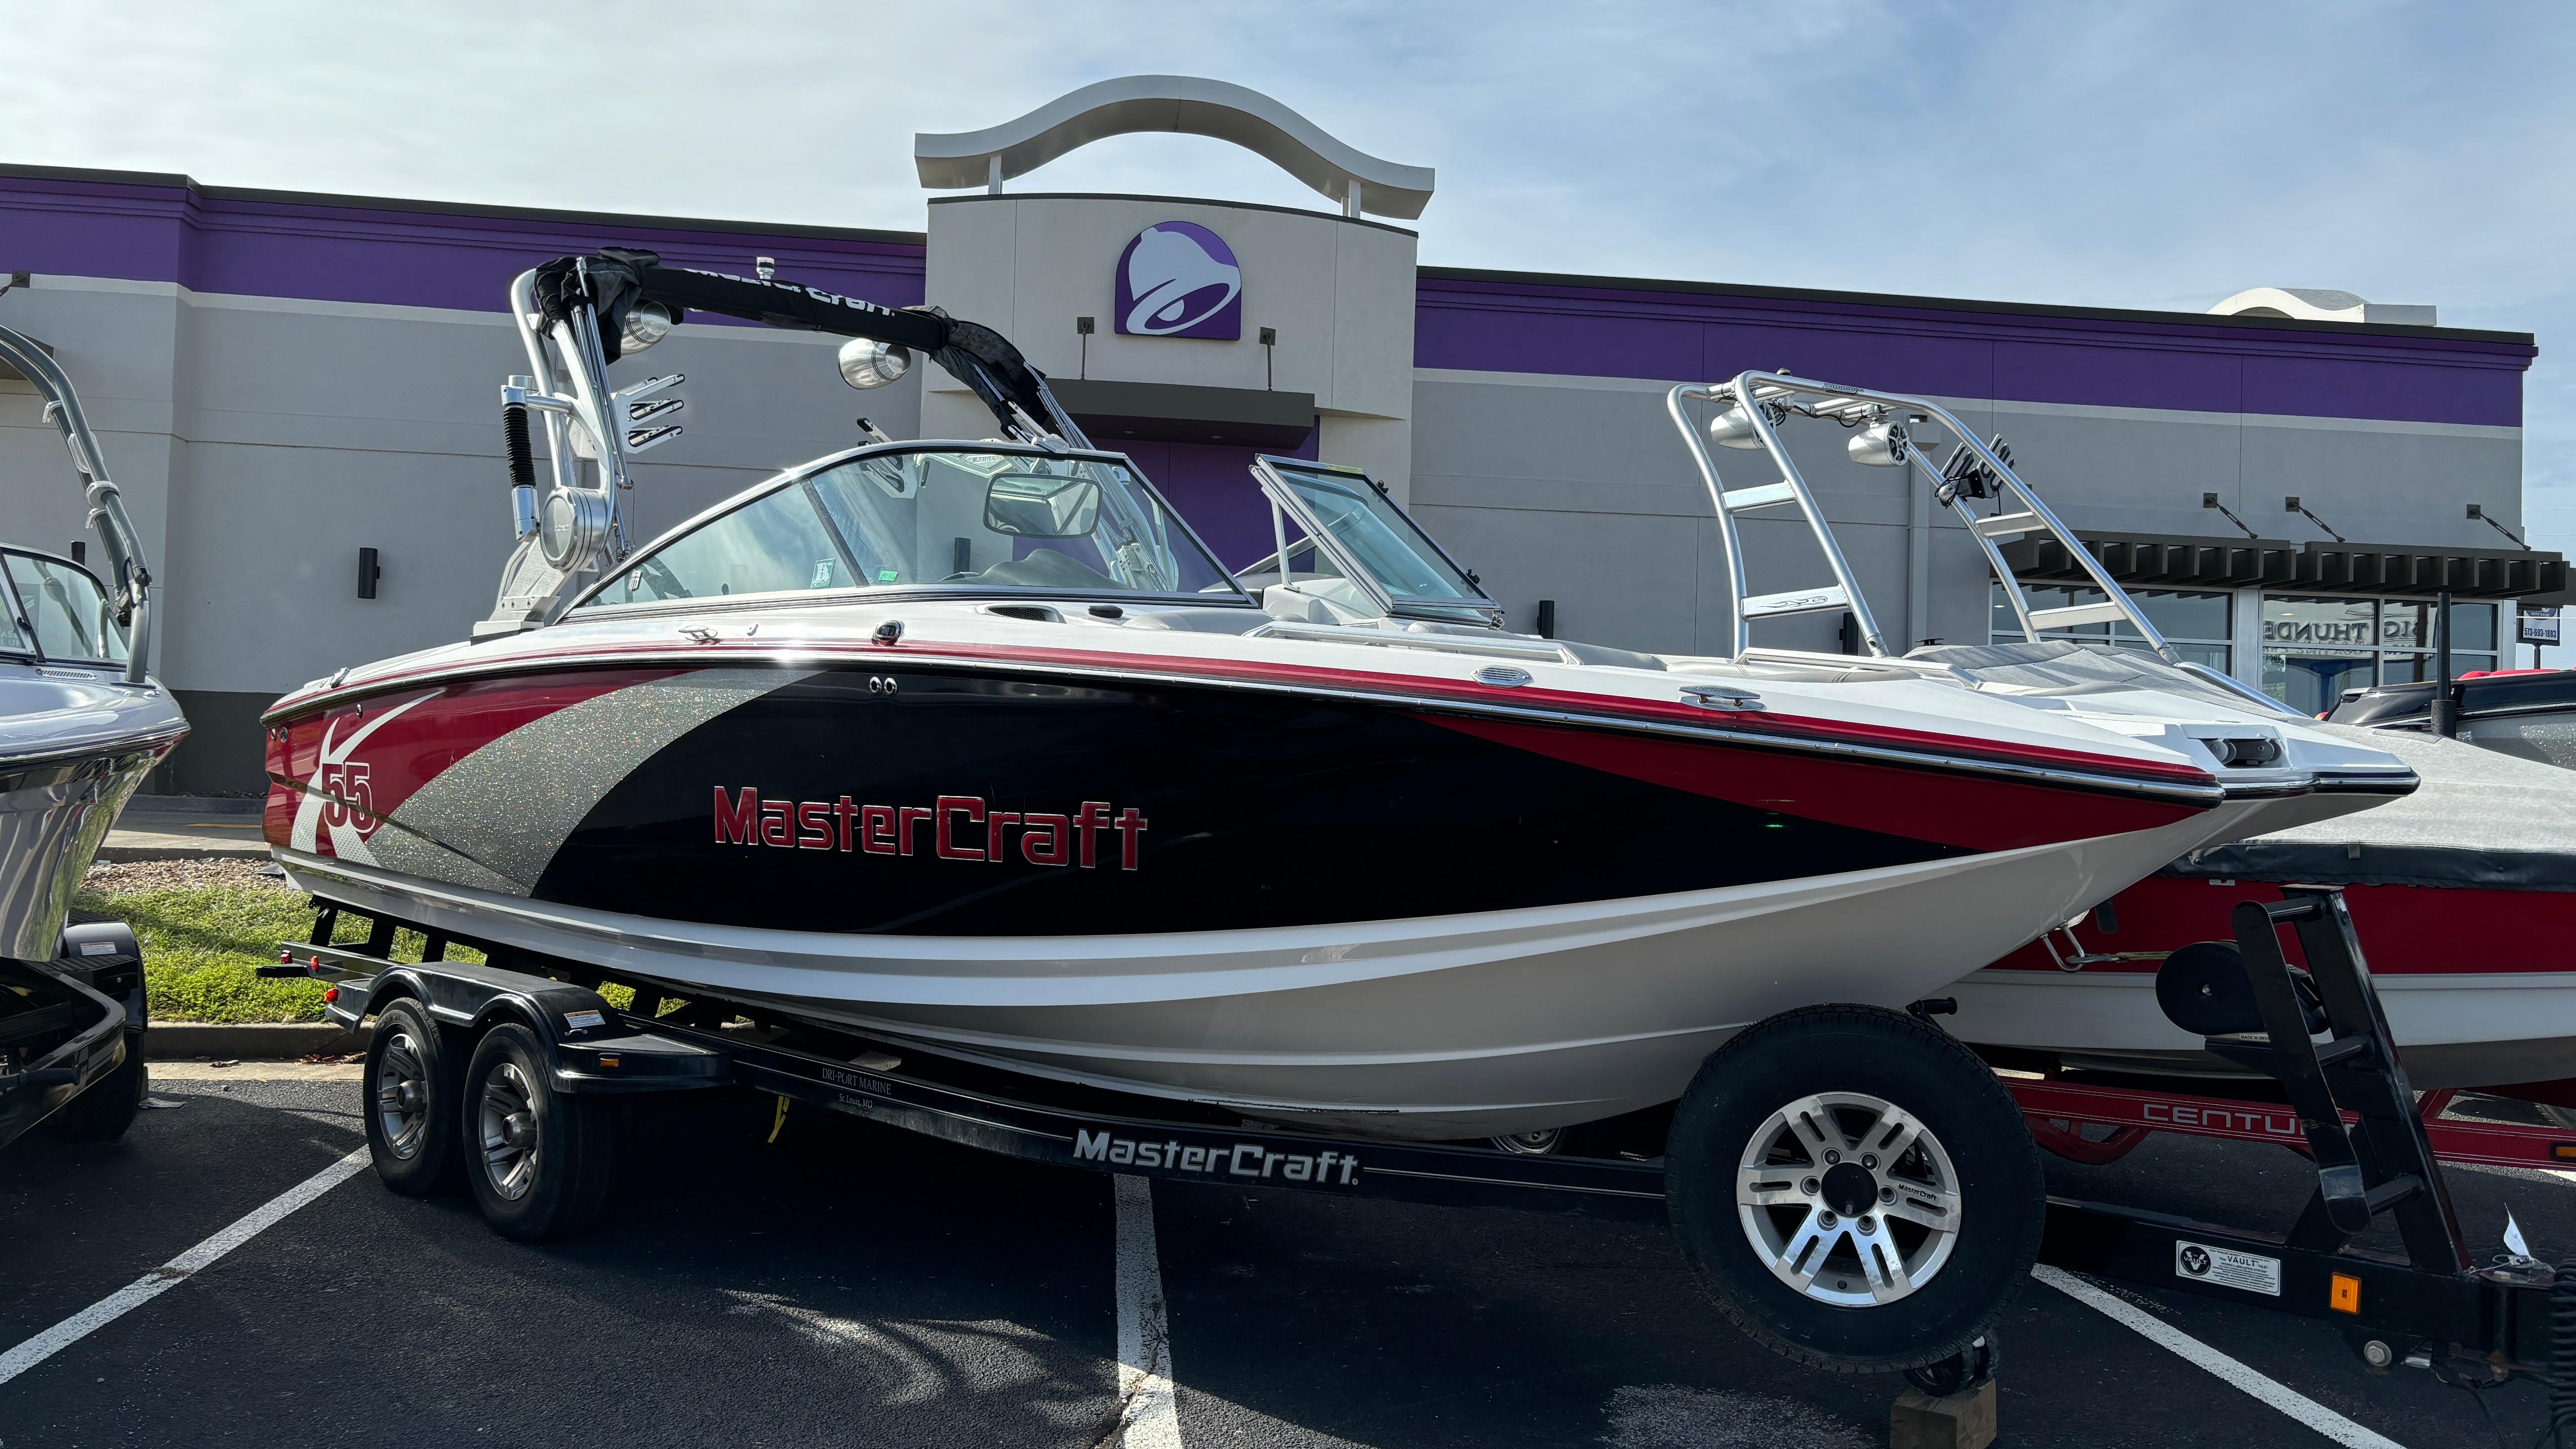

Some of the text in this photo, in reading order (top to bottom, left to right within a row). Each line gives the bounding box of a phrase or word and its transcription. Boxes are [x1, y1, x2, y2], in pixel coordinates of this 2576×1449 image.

[713, 786, 1148, 870] MasterCraft
[859, 1077, 891, 1095] MARINE
[862, 1099, 873, 1109] MO
[2144, 1103, 2355, 1136] CENTU
[1898, 1184, 1937, 1201] MasterCraft
[2184, 1256, 2208, 1265] VAULT
